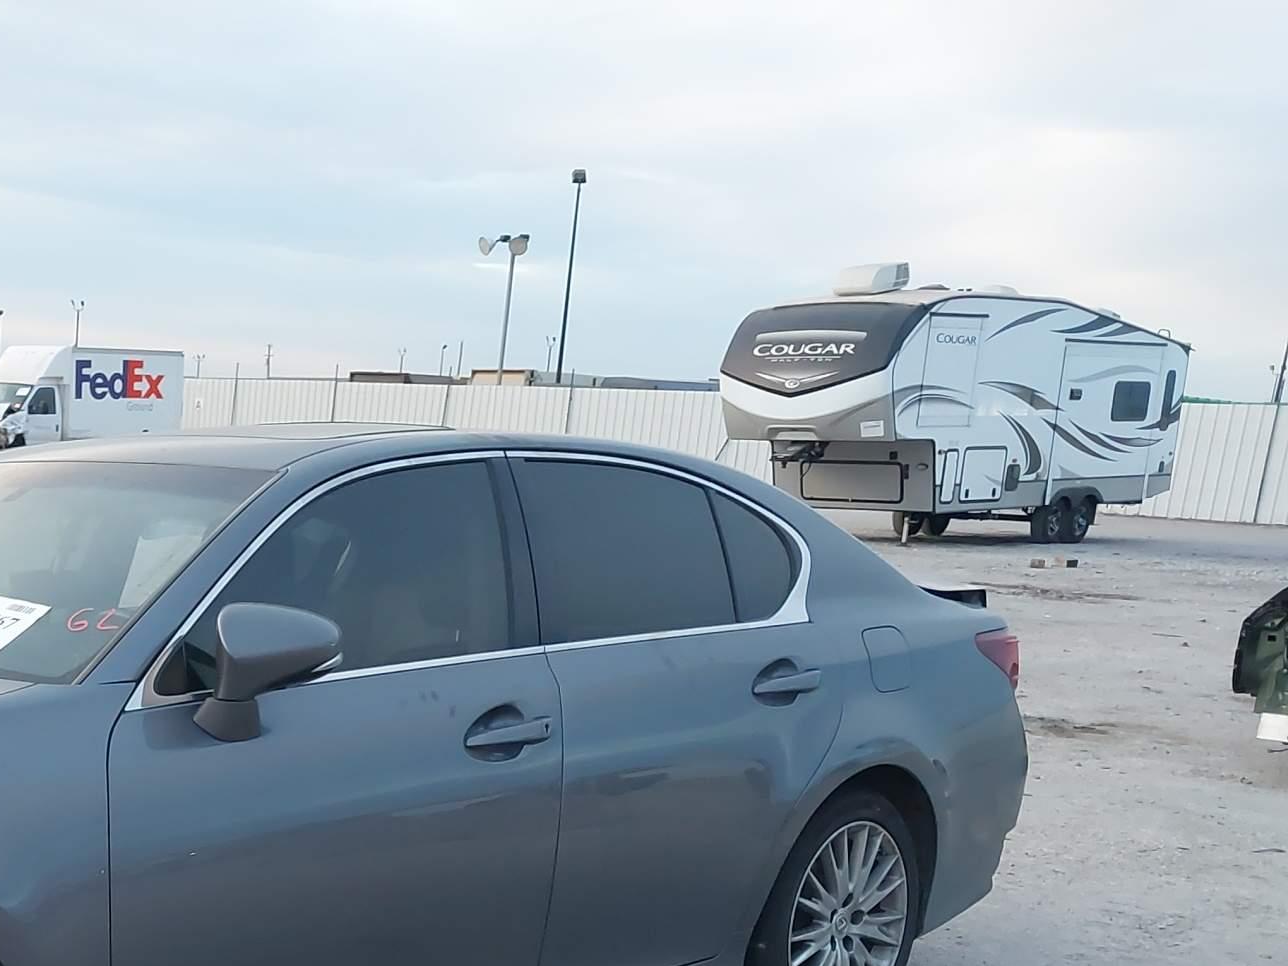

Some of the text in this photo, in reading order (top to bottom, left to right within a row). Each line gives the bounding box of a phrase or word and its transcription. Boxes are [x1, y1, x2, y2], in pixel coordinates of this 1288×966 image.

[936, 333, 977, 345] COUGAR
[753, 343, 856, 357] COUGAR
[74, 359, 165, 400] FedEx
